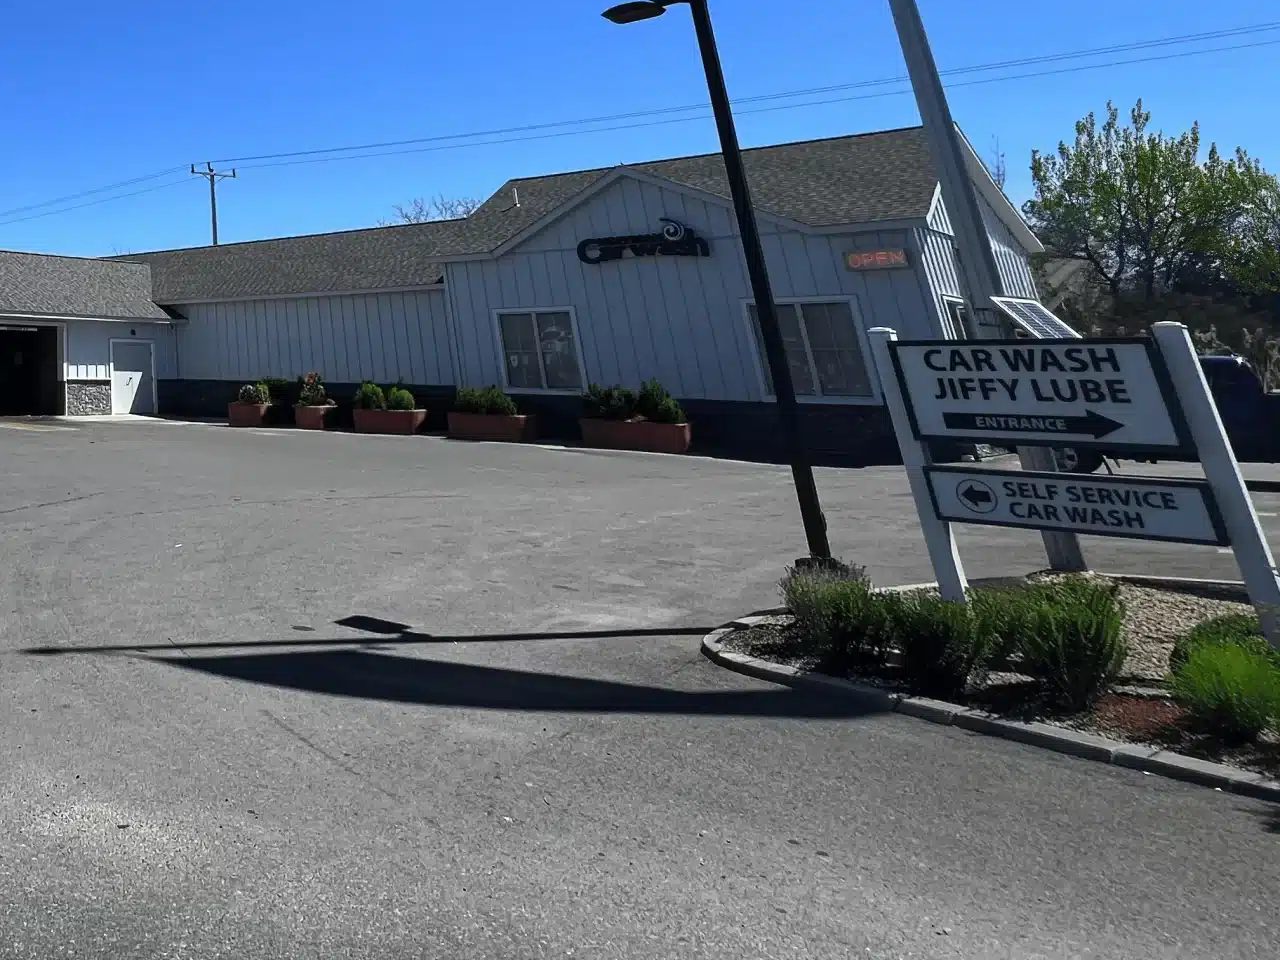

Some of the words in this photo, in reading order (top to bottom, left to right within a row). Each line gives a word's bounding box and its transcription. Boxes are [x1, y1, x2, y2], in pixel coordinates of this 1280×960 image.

[848, 251, 906, 269] OPEN
[923, 349, 997, 372] CAR
[999, 347, 1121, 373] WASH
[934, 378, 1019, 401] JIFFY
[1029, 379, 1132, 403] LUBE
[975, 416, 1068, 431] ENTRANCE
[1002, 481, 1059, 501] SELF
[1065, 486, 1179, 510] SERVICE
[1008, 502, 1063, 522] CAR
[1063, 506, 1145, 529] WASH
